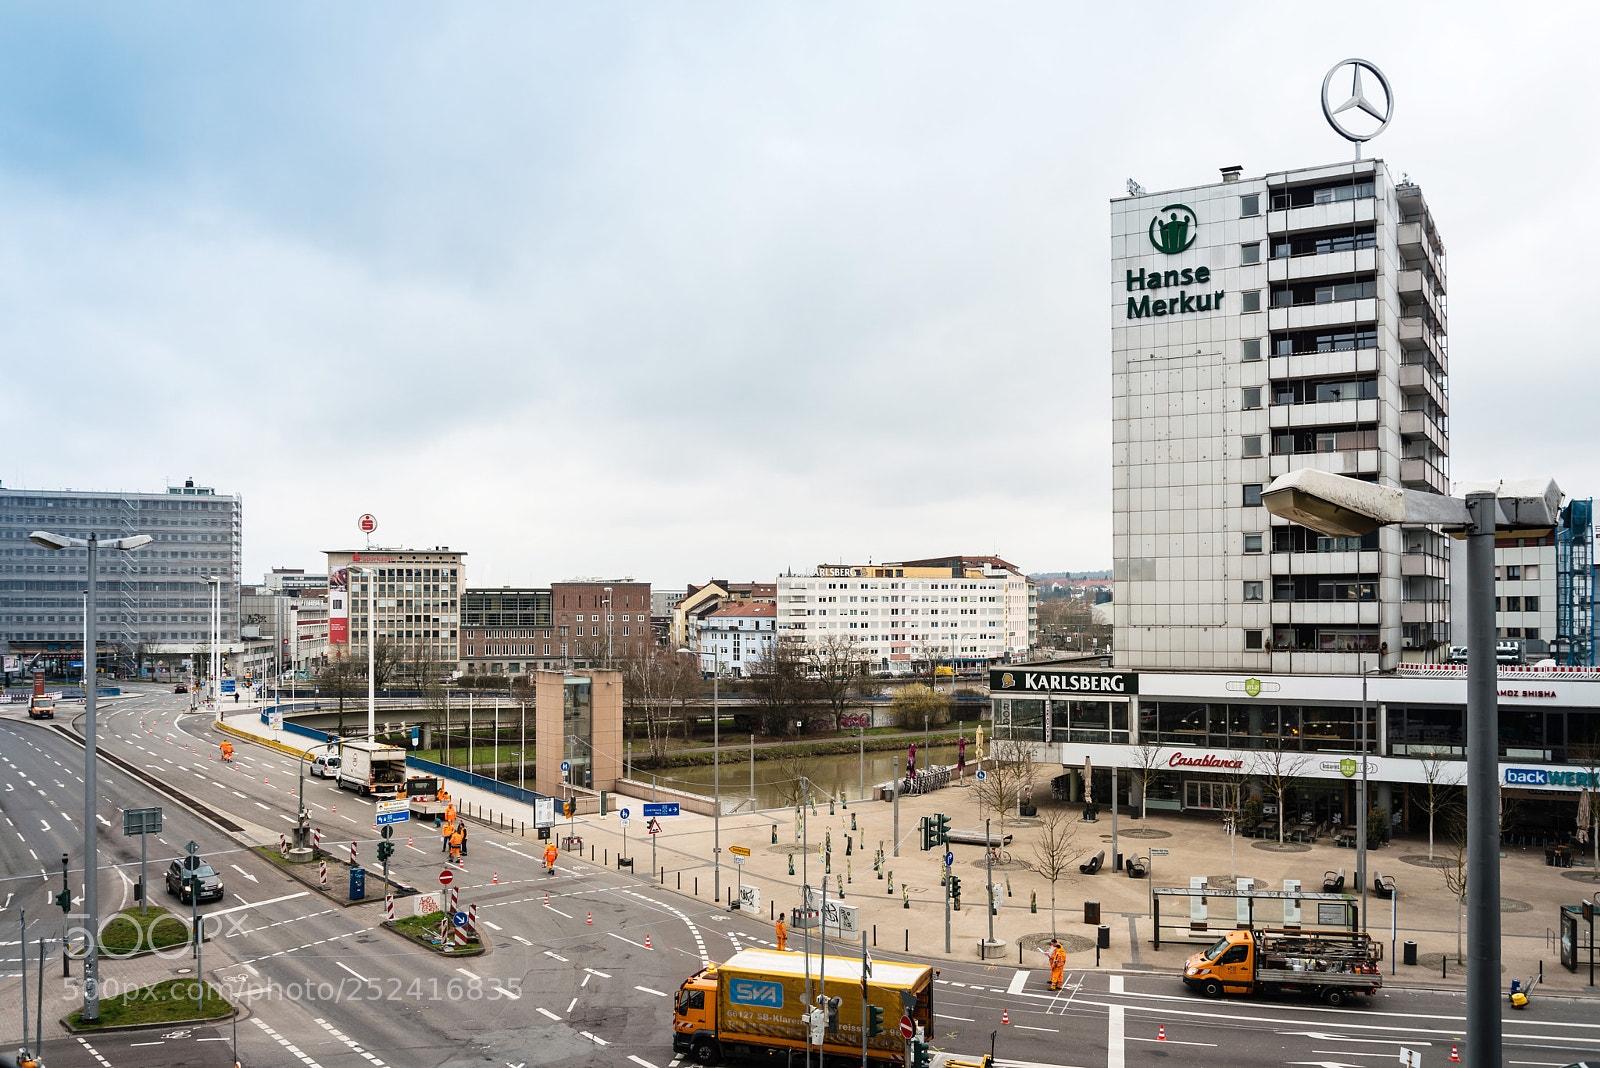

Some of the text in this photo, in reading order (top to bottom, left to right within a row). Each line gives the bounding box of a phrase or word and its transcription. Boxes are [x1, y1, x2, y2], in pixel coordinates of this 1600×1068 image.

[1126, 266, 1210, 291] Hanse
[1127, 290, 1224, 319] Merkur
[807, 567, 857, 577] ARLSBERG
[1025, 673, 1125, 692] KARLSBERG
[1522, 690, 1557, 698] SHISHA
[1169, 752, 1243, 769] Casablanca
[736, 983, 776, 1003] SVA
[727, 1010, 754, 1019] 66127
